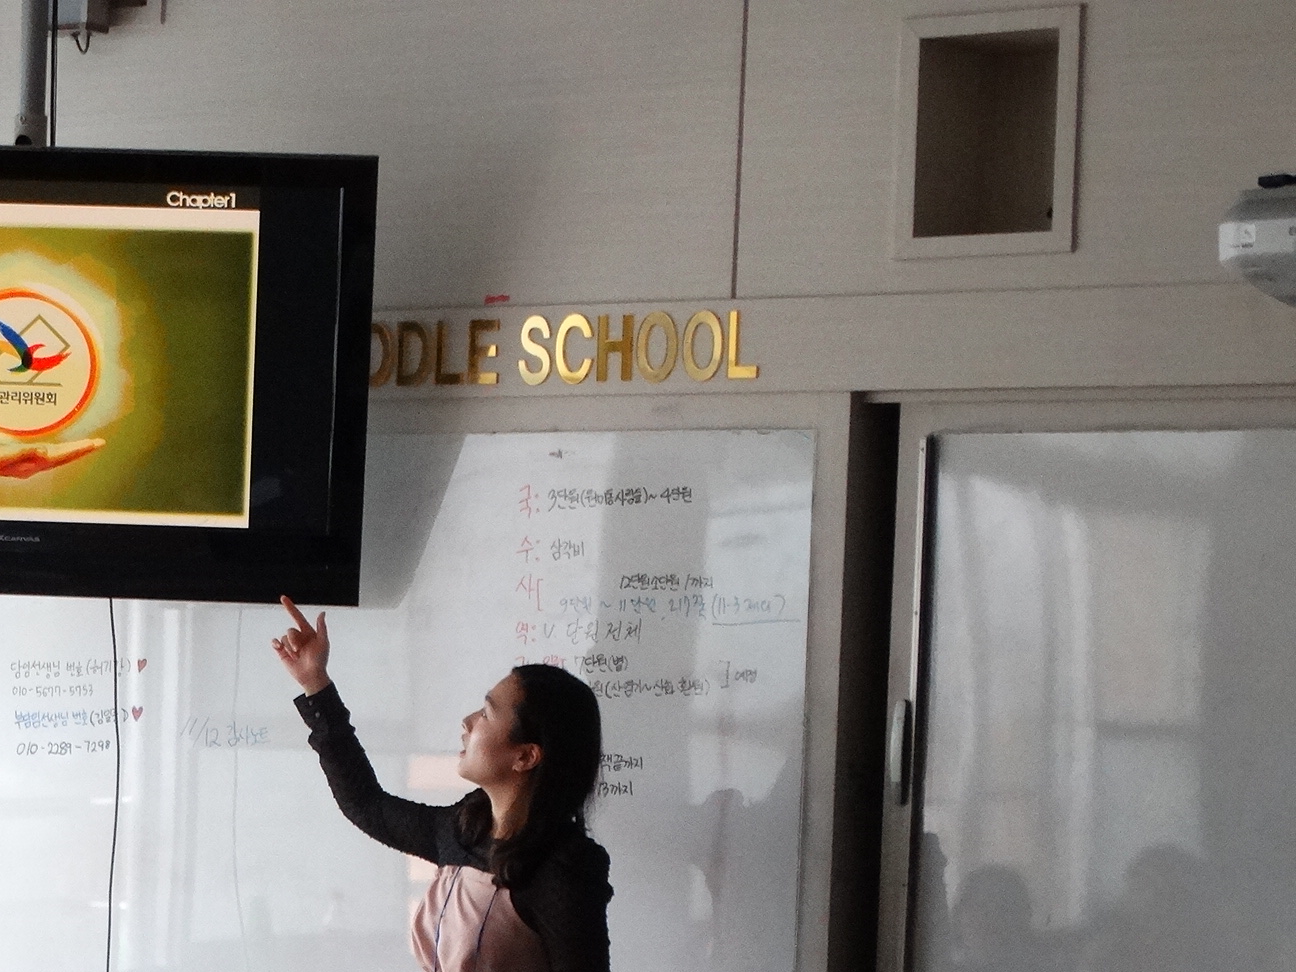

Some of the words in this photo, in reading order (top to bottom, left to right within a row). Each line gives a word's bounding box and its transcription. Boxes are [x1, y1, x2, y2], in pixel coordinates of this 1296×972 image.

[518, 310, 760, 386] SCHOOL
[550, 538, 585, 561] 삼각비
[10, 658, 61, 680] 담임선생님
